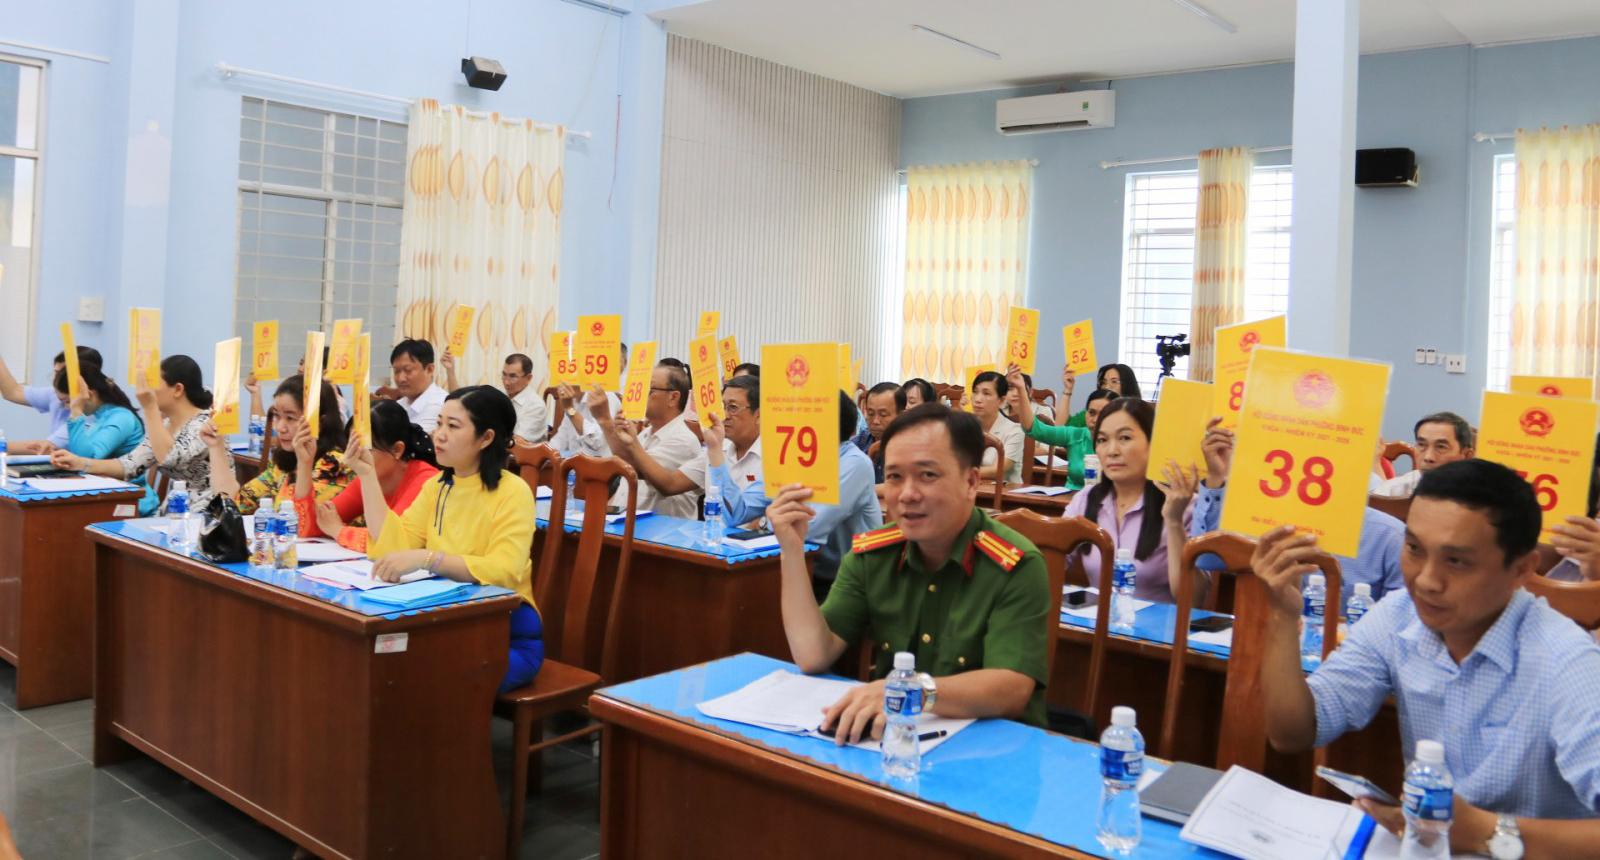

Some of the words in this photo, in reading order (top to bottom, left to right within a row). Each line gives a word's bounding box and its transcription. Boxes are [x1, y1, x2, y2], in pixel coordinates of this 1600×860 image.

[256, 352, 272, 368] 07
[1011, 340, 1028, 359] 63
[1072, 348, 1089, 364] 52
[584, 354, 608, 375] 59
[627, 382, 643, 402] 58
[700, 382, 716, 407] 66
[776, 425, 818, 468] 79
[1259, 449, 1334, 506] 38
[1516, 470, 1559, 511] 6
